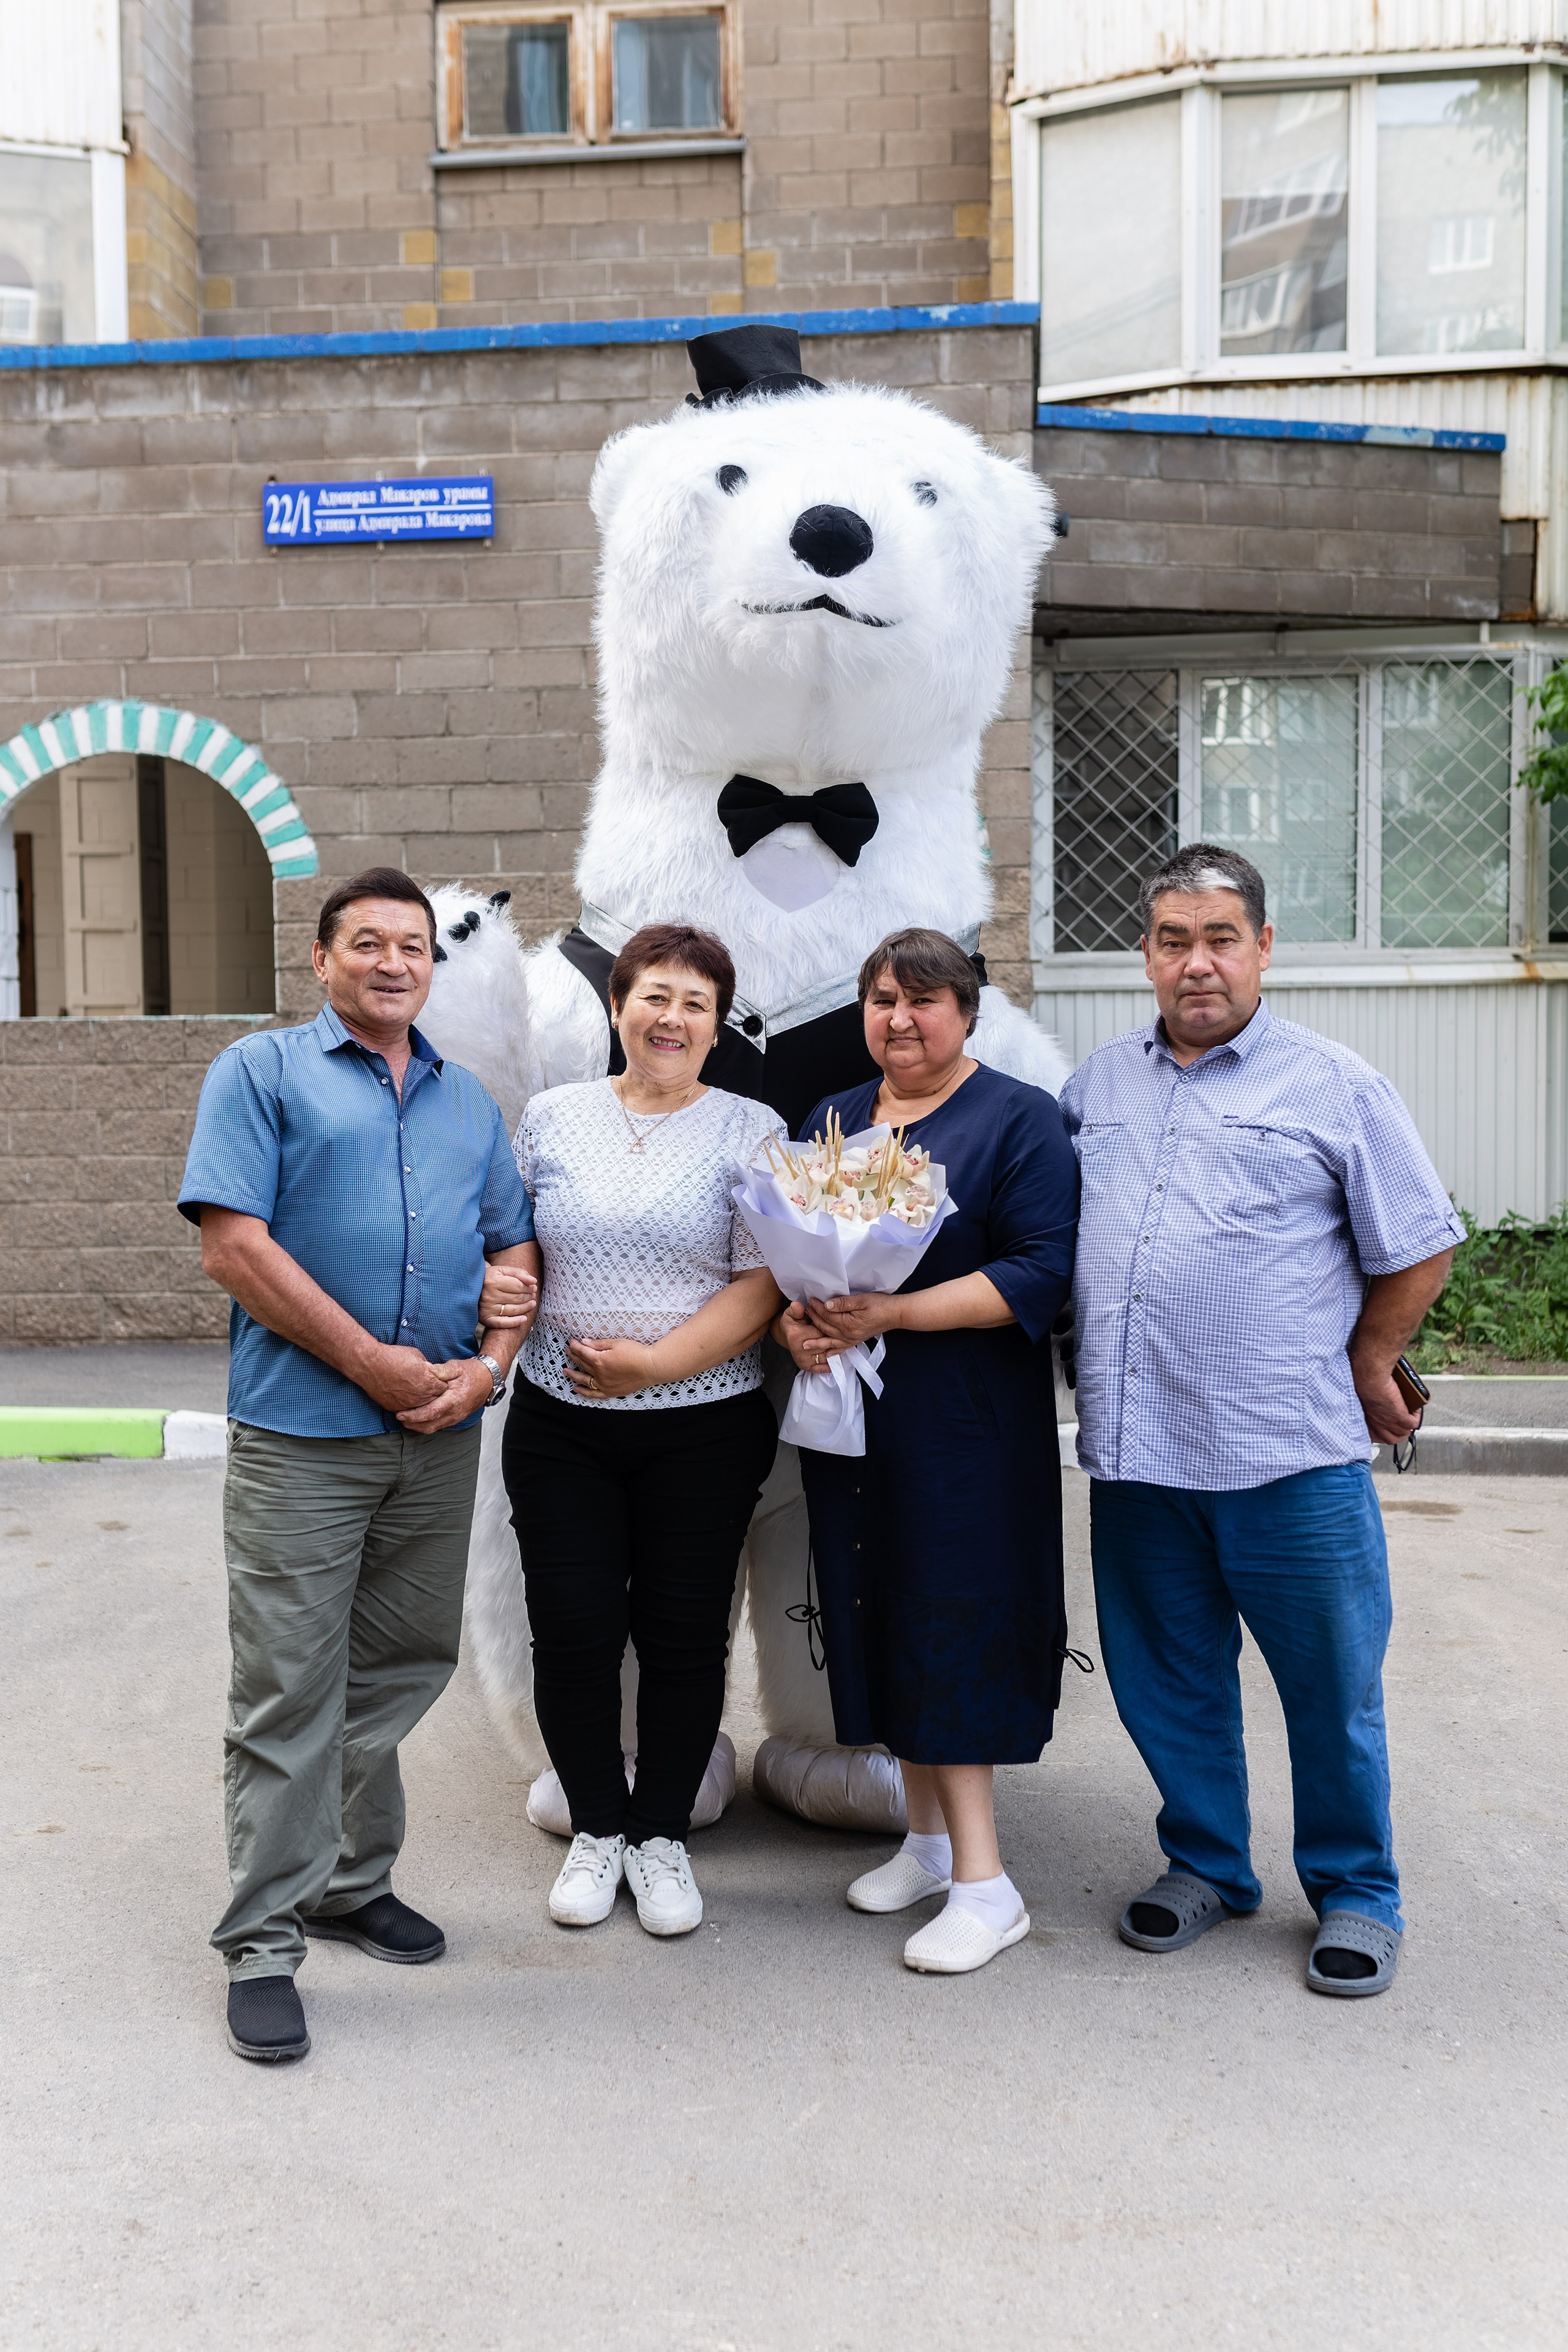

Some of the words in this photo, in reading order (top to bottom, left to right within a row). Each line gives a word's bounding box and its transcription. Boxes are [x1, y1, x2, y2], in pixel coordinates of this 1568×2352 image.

[317, 489, 377, 508] Адмирал
[380, 486, 439, 506] Макаров
[443, 486, 488, 505] урамы
[266, 490, 311, 537] 22/1
[315, 518, 356, 536] улица
[358, 514, 423, 534] Адмирала
[425, 511, 492, 531] Макарова
